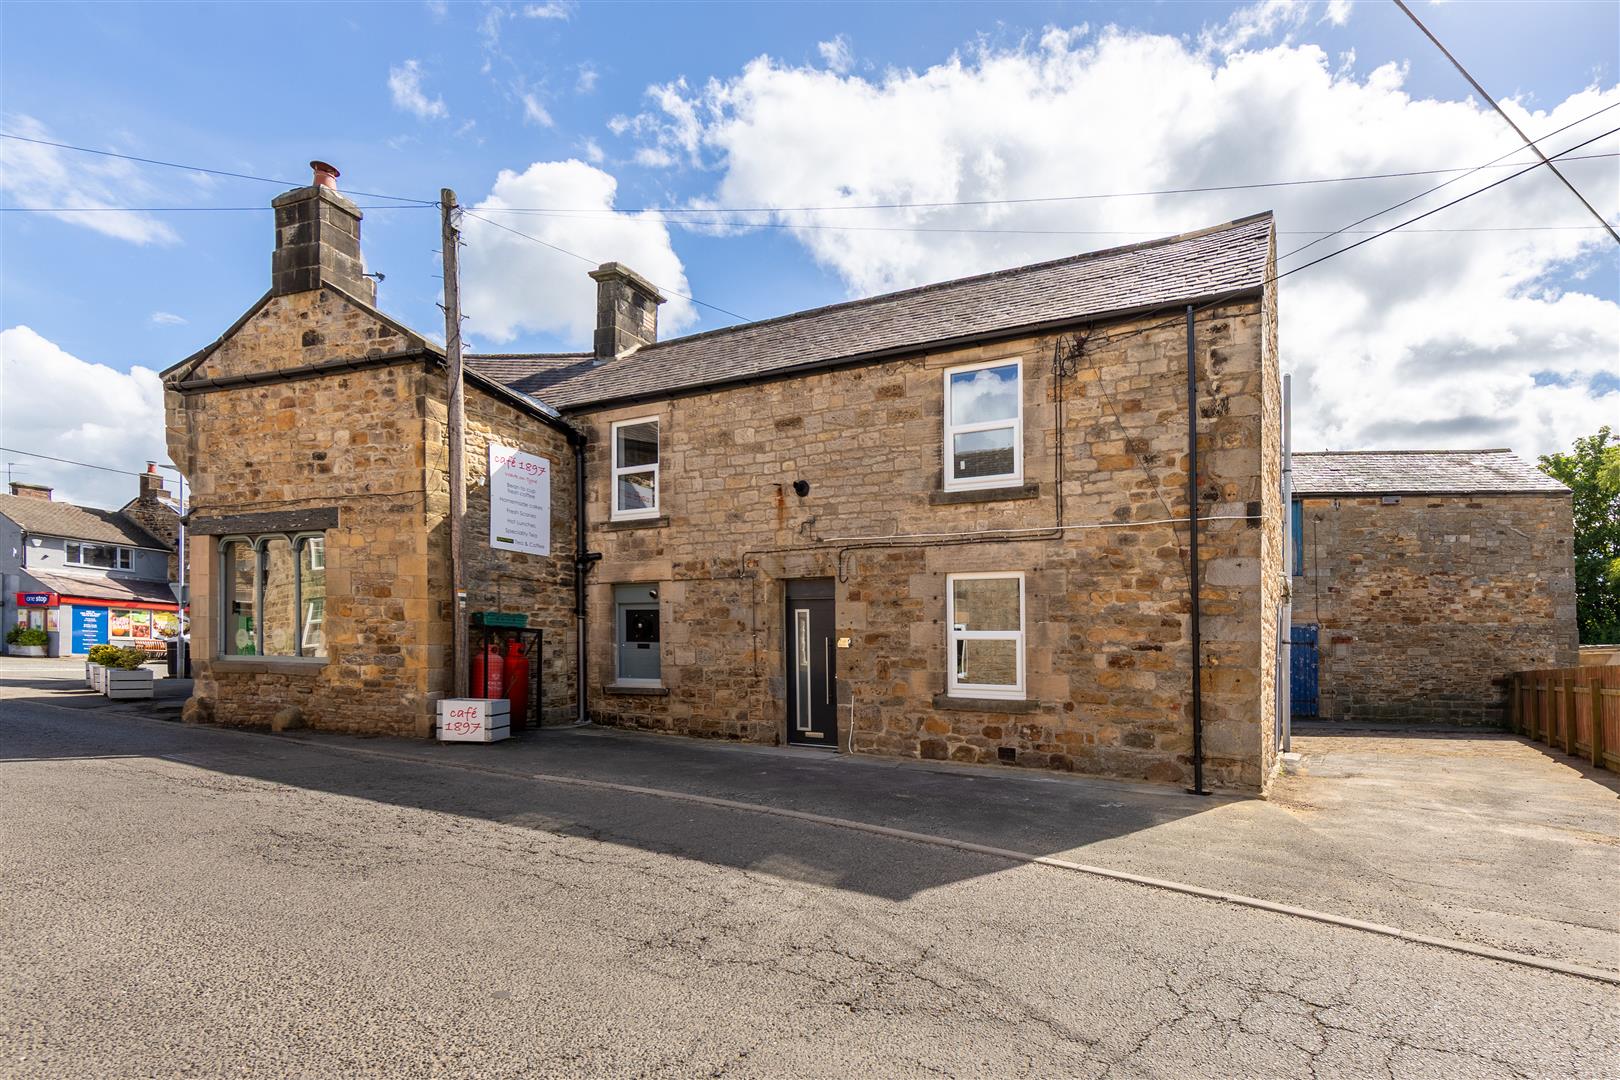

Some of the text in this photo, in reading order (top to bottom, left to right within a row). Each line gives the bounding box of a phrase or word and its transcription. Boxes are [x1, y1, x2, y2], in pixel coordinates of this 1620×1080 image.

[519, 462, 546, 477] 1897
[35, 595, 47, 603] stop
[450, 706, 477, 721] café
[445, 722, 481, 735] 1897
